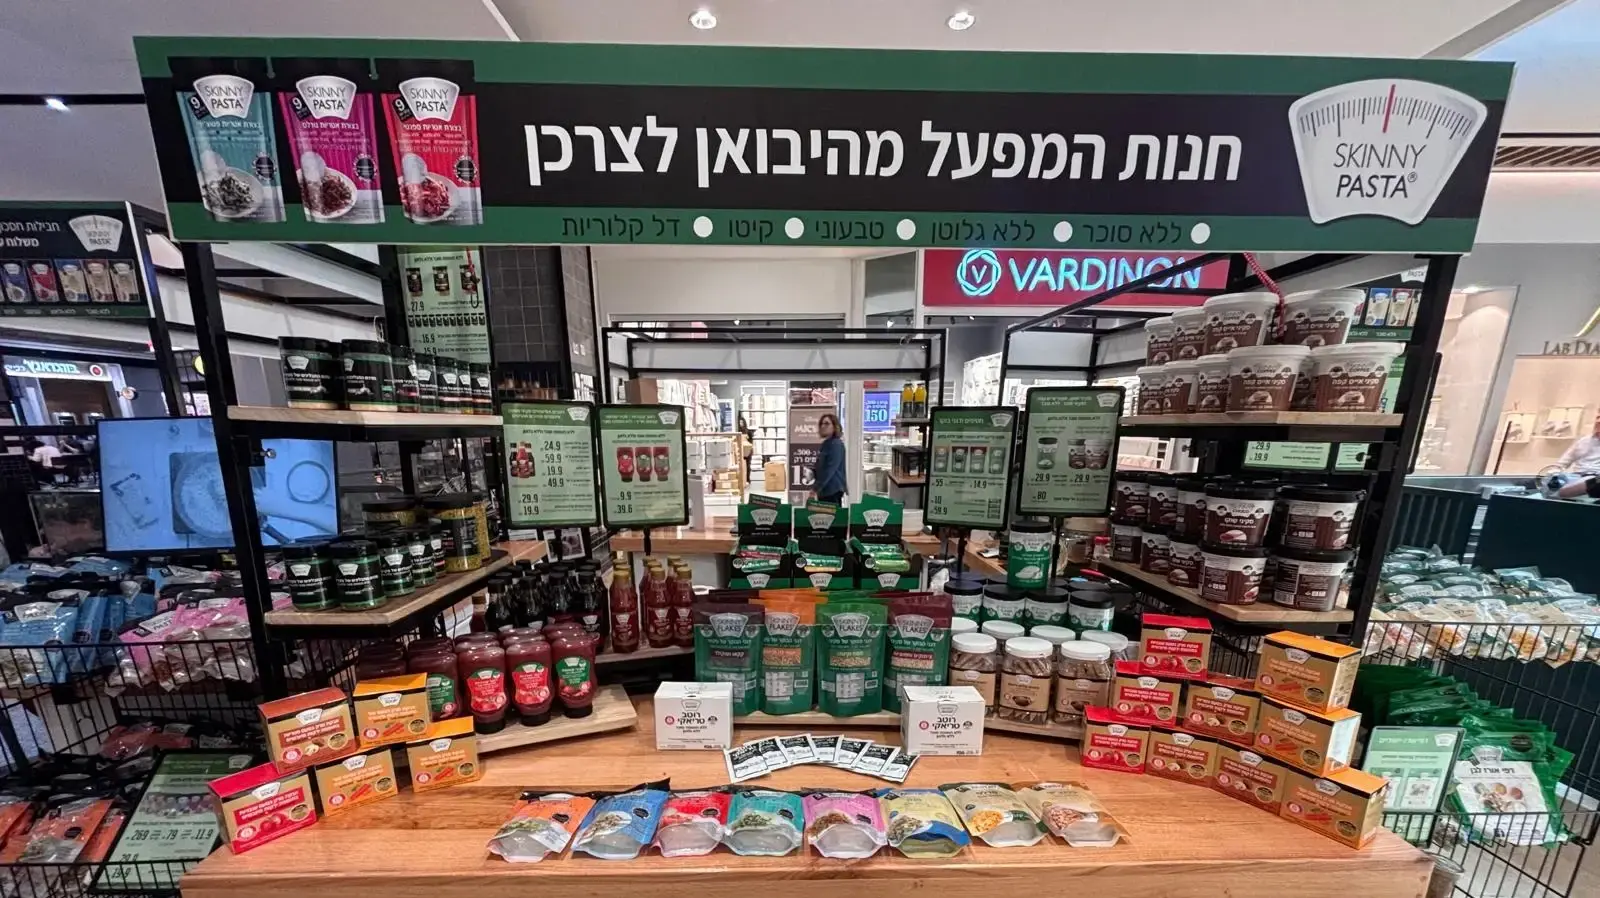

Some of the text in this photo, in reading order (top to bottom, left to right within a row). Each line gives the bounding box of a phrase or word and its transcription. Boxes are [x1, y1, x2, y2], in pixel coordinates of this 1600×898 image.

[204, 85, 244, 97] SKINNY
[306, 86, 346, 98] SKINNY
[410, 88, 449, 100] SKINNY
[524, 116, 1242, 188] חנות המפעל מהיבואן לצרכן
[1333, 144, 1427, 169] SKINNY
[562, 214, 680, 241] דל קלוריות
[729, 219, 774, 239] קיטו
[815, 218, 885, 240] טבעוני
[931, 220, 1035, 244] ללא גלוטן
[1083, 222, 1182, 243] ללא סוכר
[1008, 256, 1204, 292] VARDINON
[543, 441, 561, 451] 24.9
[545, 453, 562, 463] 59.9
[547, 466, 563, 476] 19.9
[547, 478, 564, 488] 49.9
[522, 493, 539, 504] 29.9
[523, 506, 540, 516] 19.9
[677, 718, 706, 726] טריאקי
[1470, 765, 1482, 776] לבן
[1504, 767, 1515, 775] דפי
